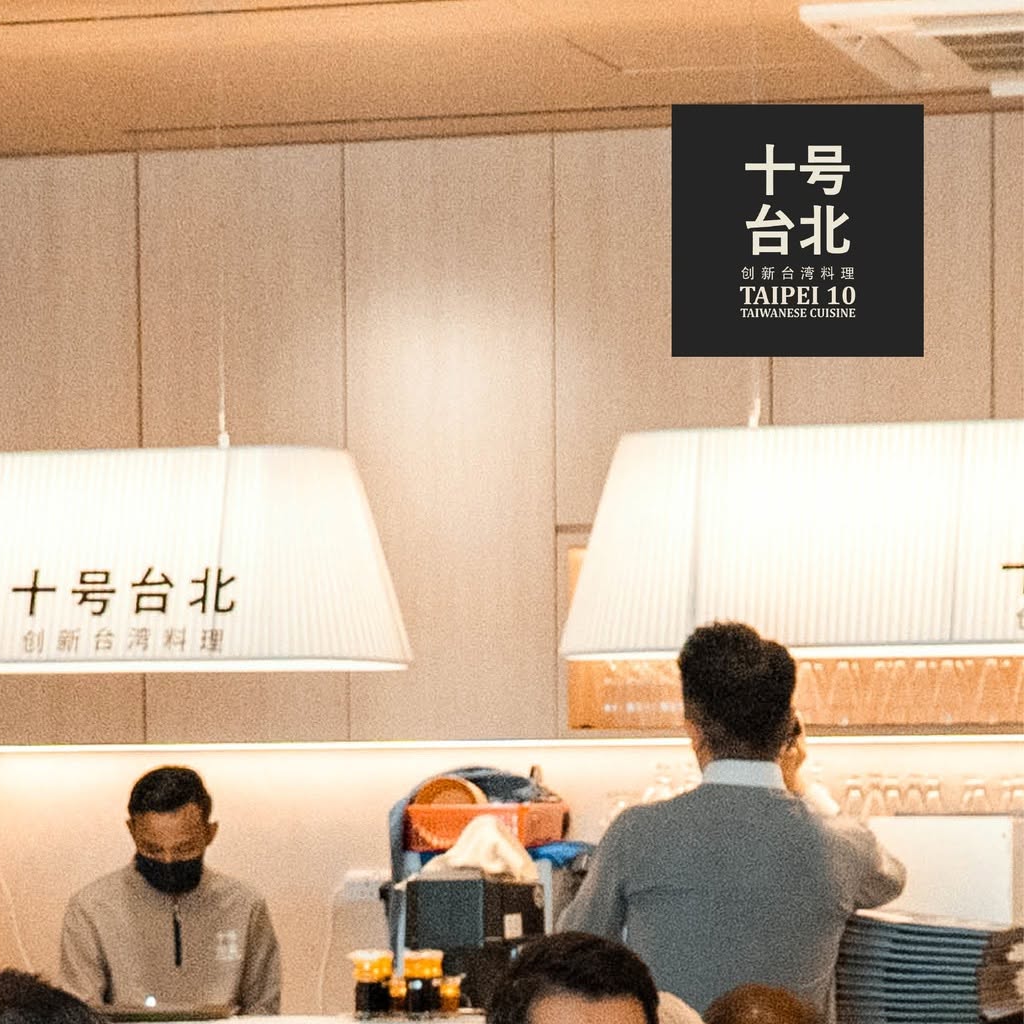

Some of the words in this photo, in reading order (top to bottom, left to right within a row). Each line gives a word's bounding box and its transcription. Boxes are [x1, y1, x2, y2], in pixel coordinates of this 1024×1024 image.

[12, 567, 235, 616] 十号台北
[23, 627, 224, 653] 创新台湾料理
